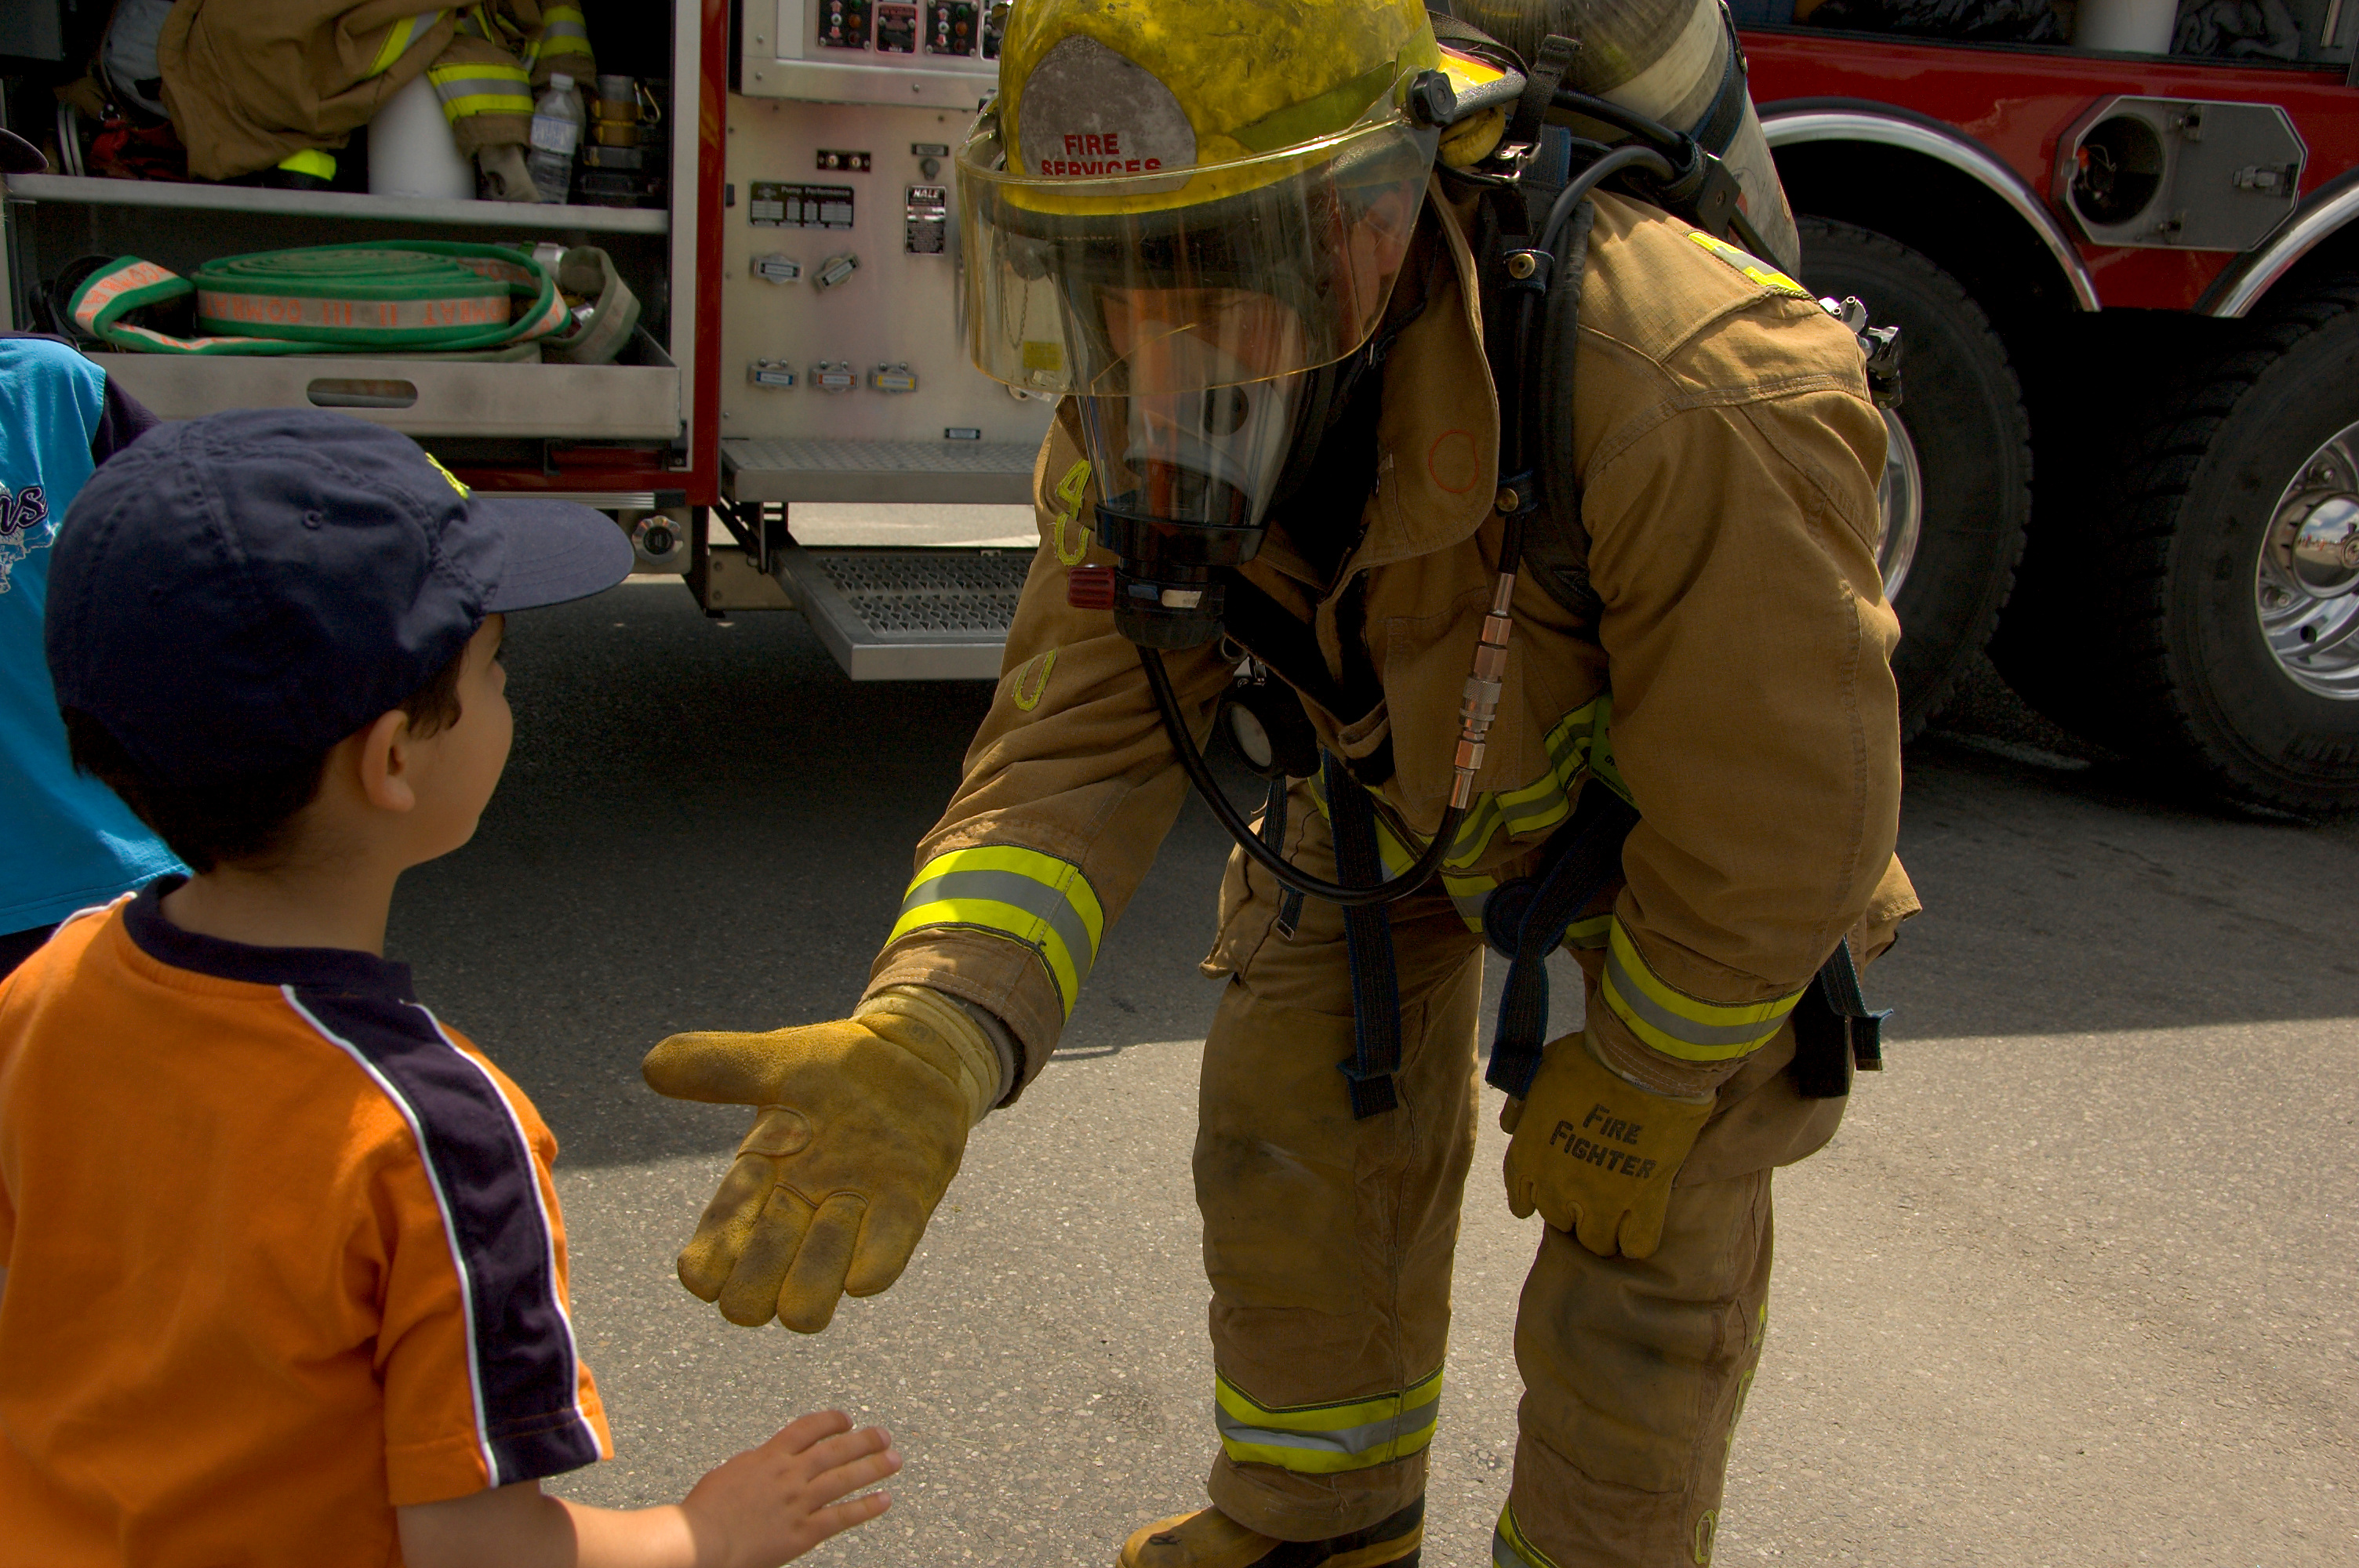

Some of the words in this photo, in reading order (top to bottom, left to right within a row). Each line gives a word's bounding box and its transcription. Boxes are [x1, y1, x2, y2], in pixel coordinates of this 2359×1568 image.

[1064, 133, 1120, 155] FIRE
[913, 188, 940, 198] HALE
[1583, 1103, 1644, 1145] FIRE
[1550, 1120, 1657, 1178] FIGHTER
